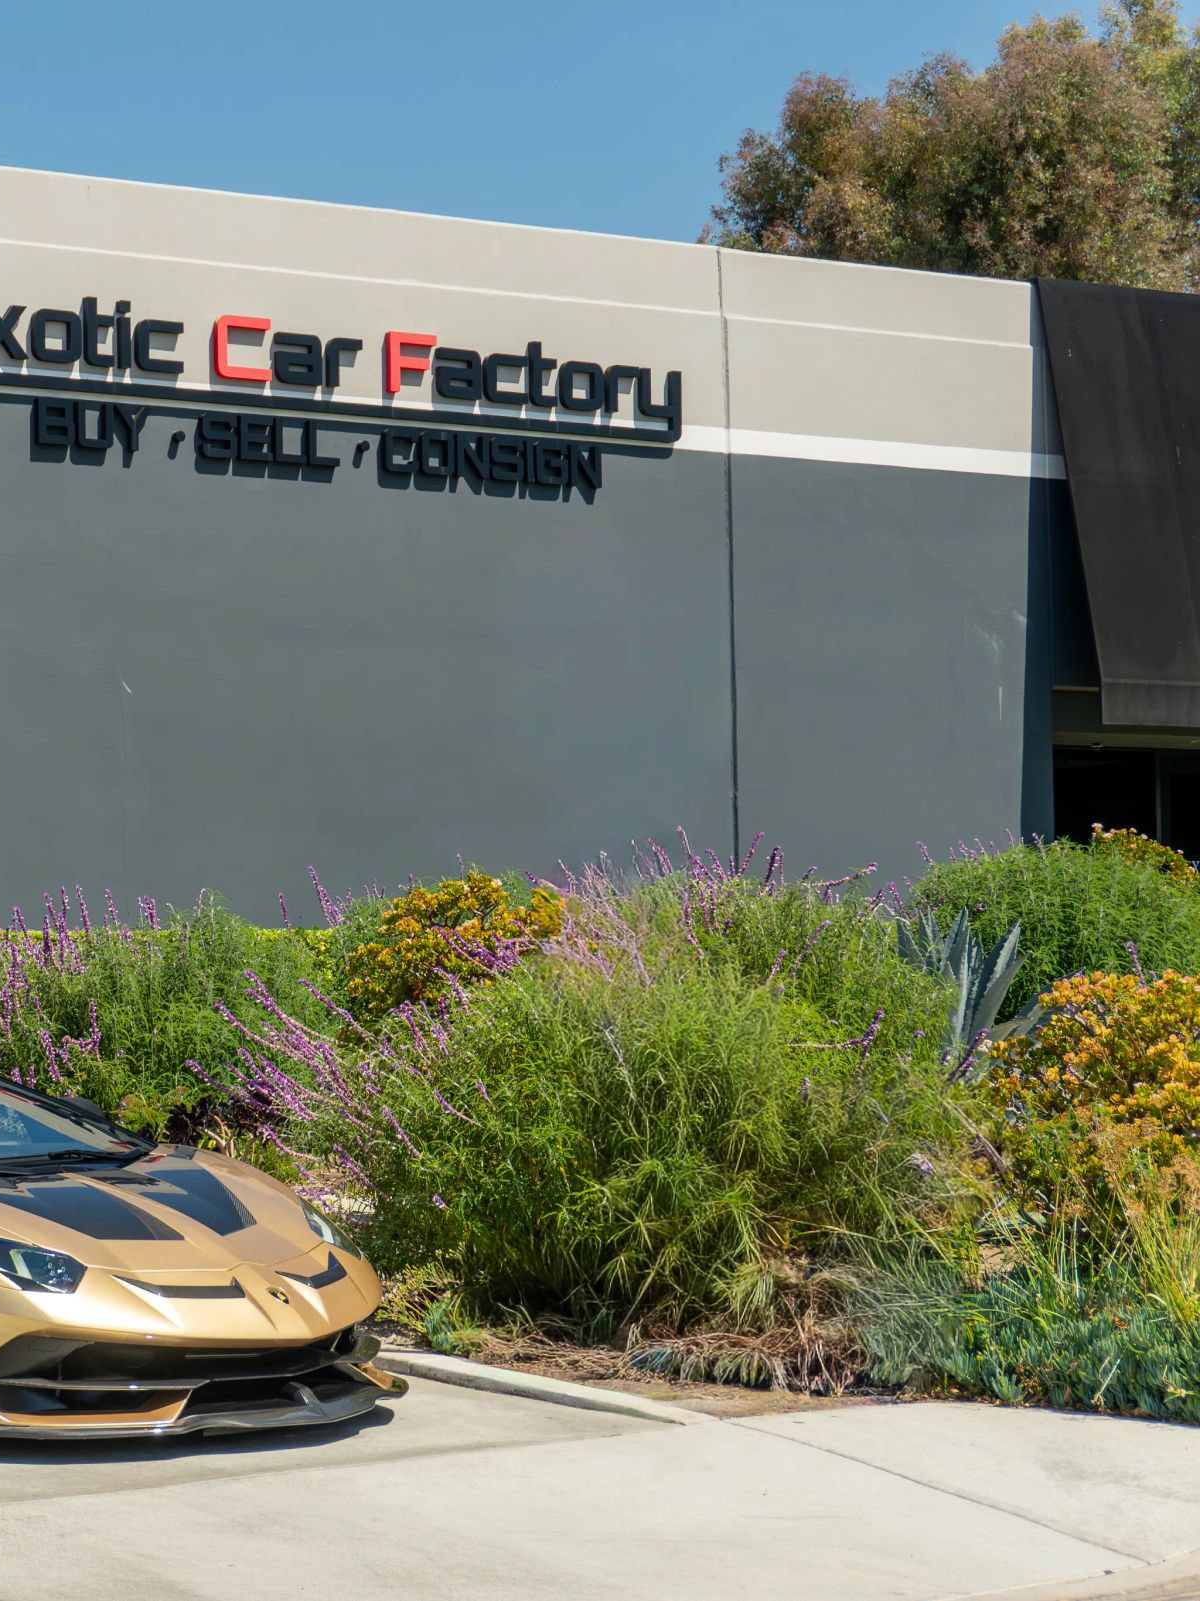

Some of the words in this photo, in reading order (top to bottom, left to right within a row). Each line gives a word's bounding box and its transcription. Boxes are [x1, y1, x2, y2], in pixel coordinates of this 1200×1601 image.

[213, 314, 363, 388] Car
[386, 330, 682, 442] Factory
[33, 398, 146, 453] BUY
[200, 411, 341, 468] SELL
[381, 427, 603, 489] CONSIGN
